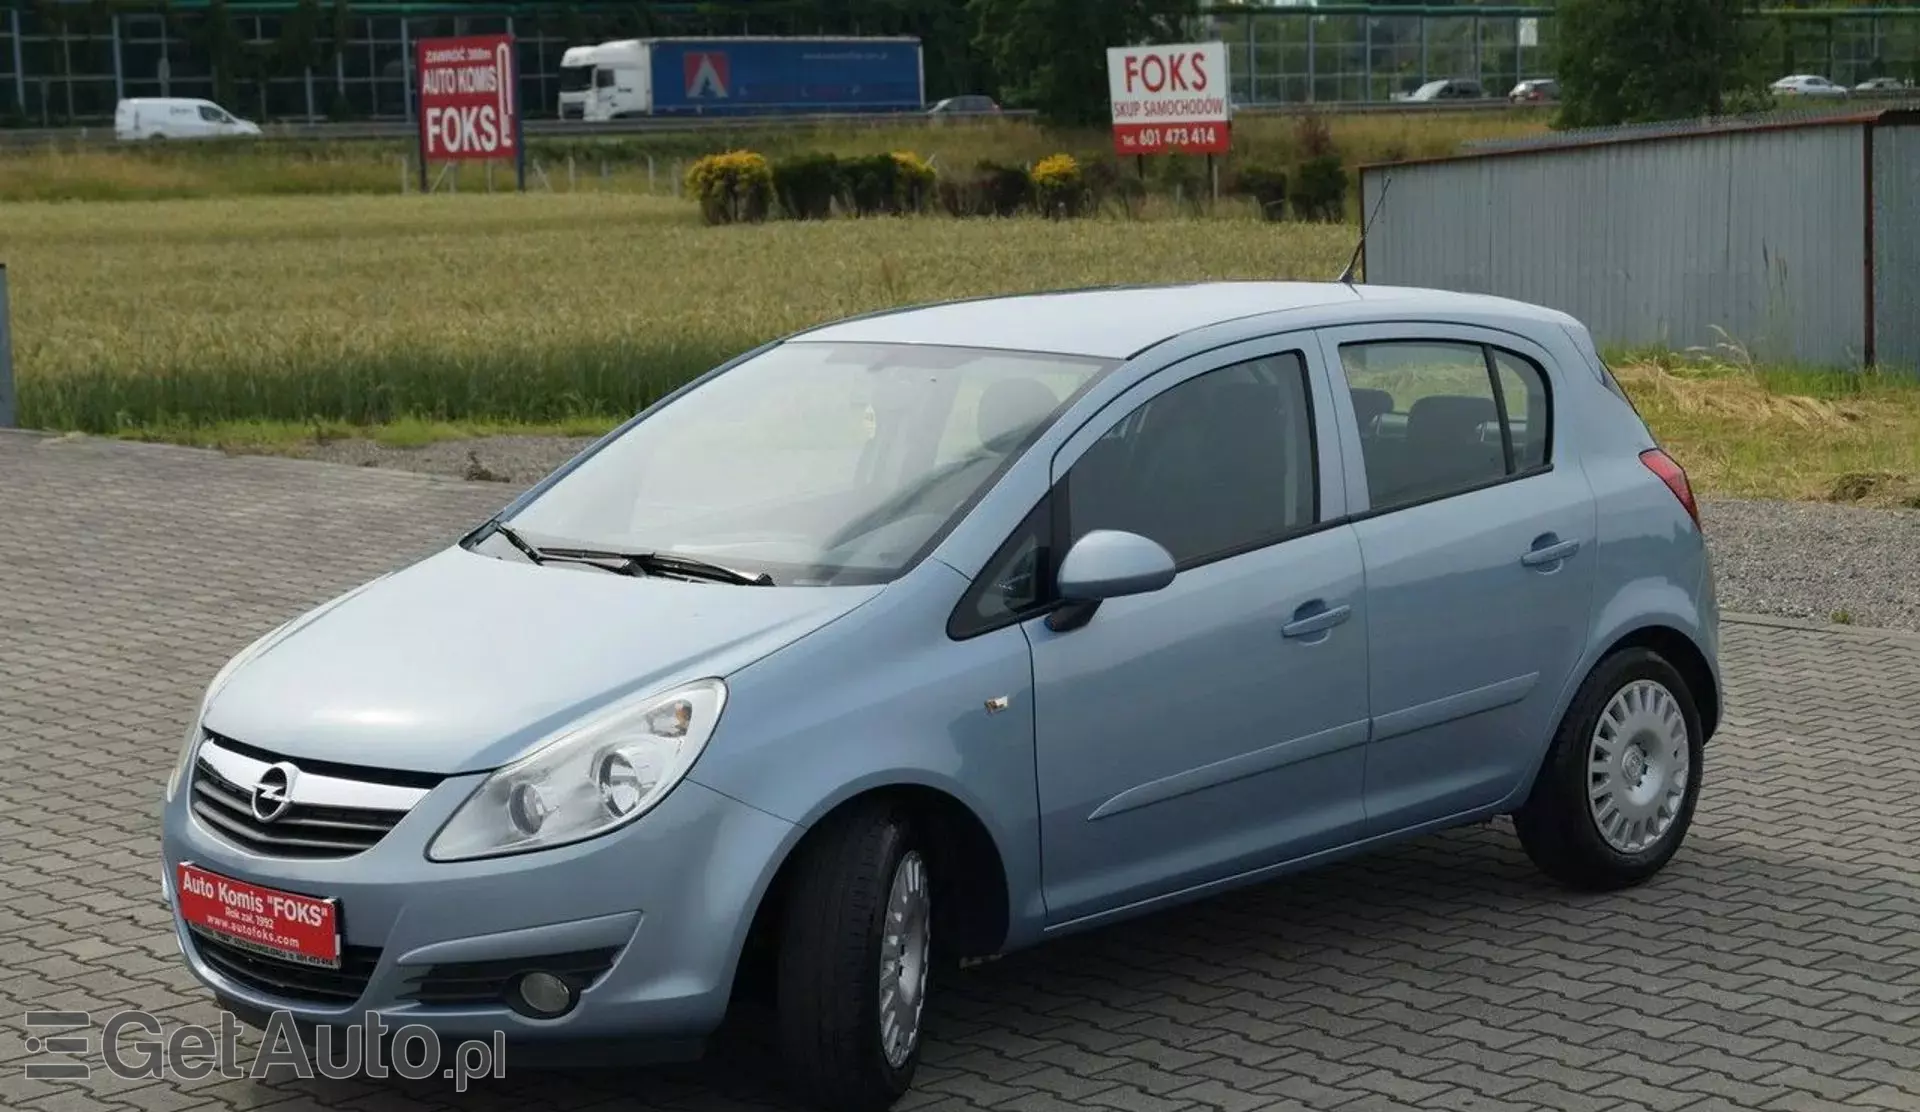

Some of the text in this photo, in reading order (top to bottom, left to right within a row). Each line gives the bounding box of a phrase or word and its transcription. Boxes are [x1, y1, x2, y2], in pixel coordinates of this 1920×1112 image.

[423, 65, 497, 94] AUTO KOMIS
[1124, 52, 1207, 92] FOKS
[1113, 101, 1141, 118] SKUP
[426, 104, 499, 153] FOKS
[1138, 128, 1161, 147] 601
[1164, 128, 1189, 145] 473
[1191, 127, 1216, 144] 414
[183, 871, 328, 927] Auto Komis "FOKS"
[206, 914, 300, 949] www.autofoks.com
